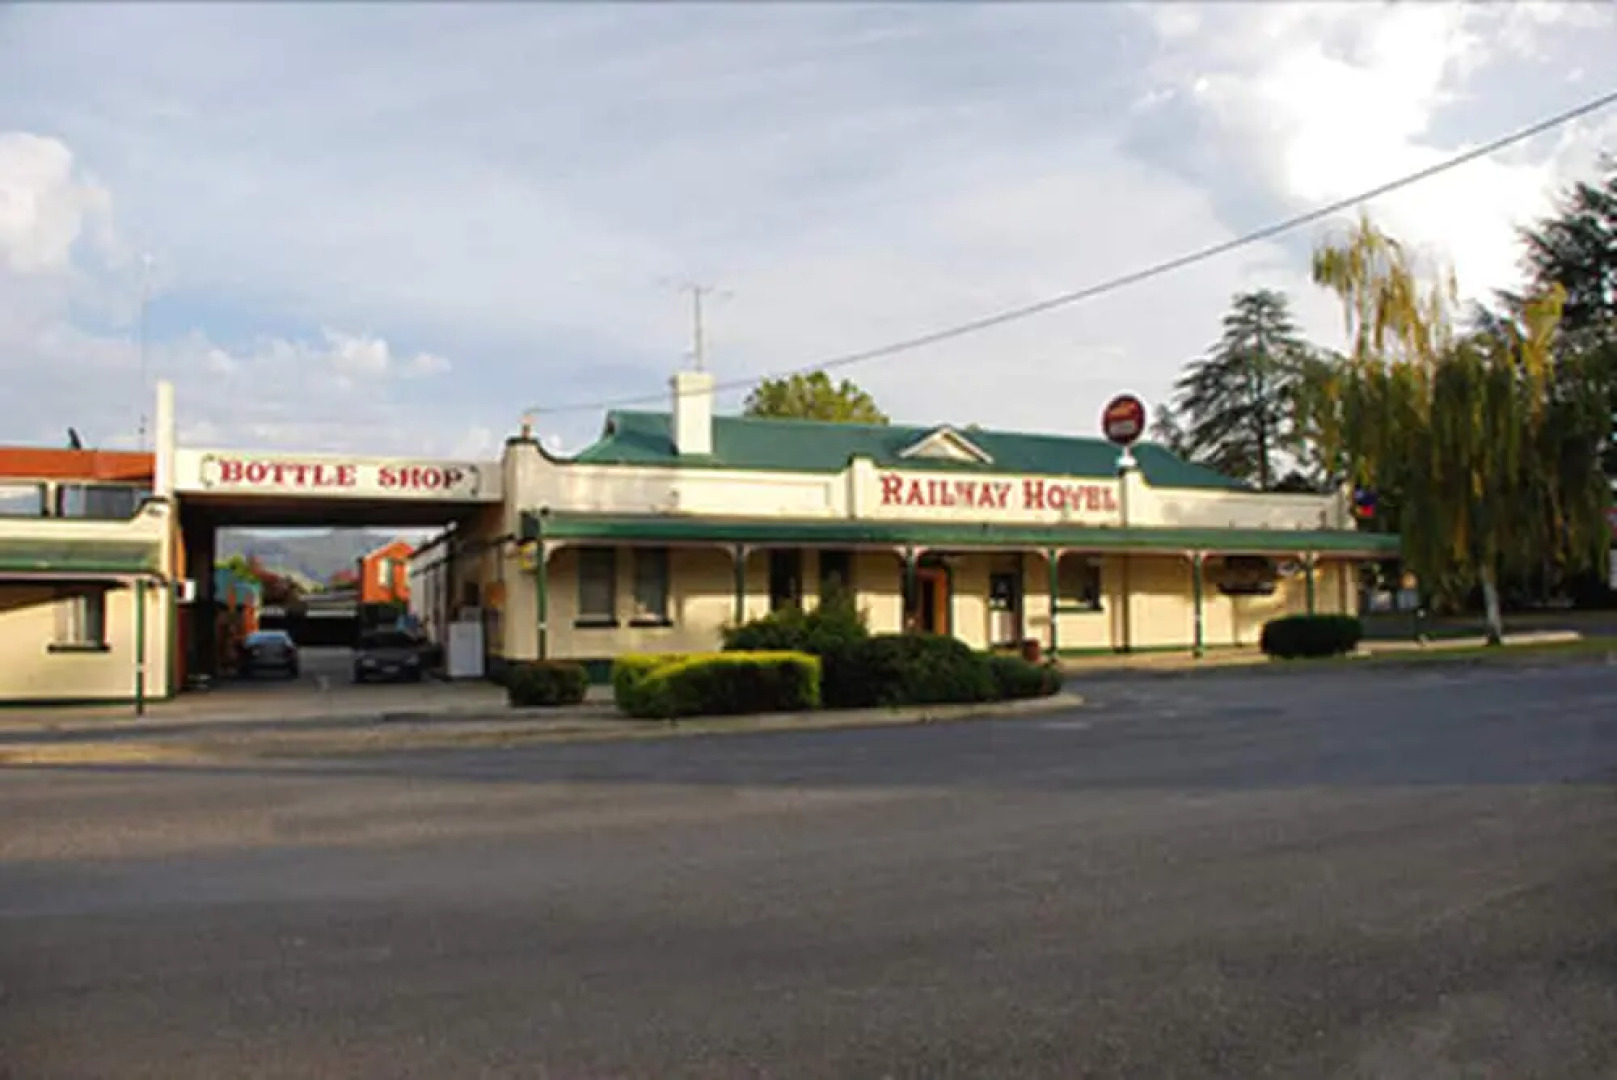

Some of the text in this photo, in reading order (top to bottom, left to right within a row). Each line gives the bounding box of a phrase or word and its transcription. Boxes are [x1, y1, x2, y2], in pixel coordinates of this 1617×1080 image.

[219, 460, 463, 489] BOTTLE SHOP
[881, 473, 1012, 508] RAILWAY
